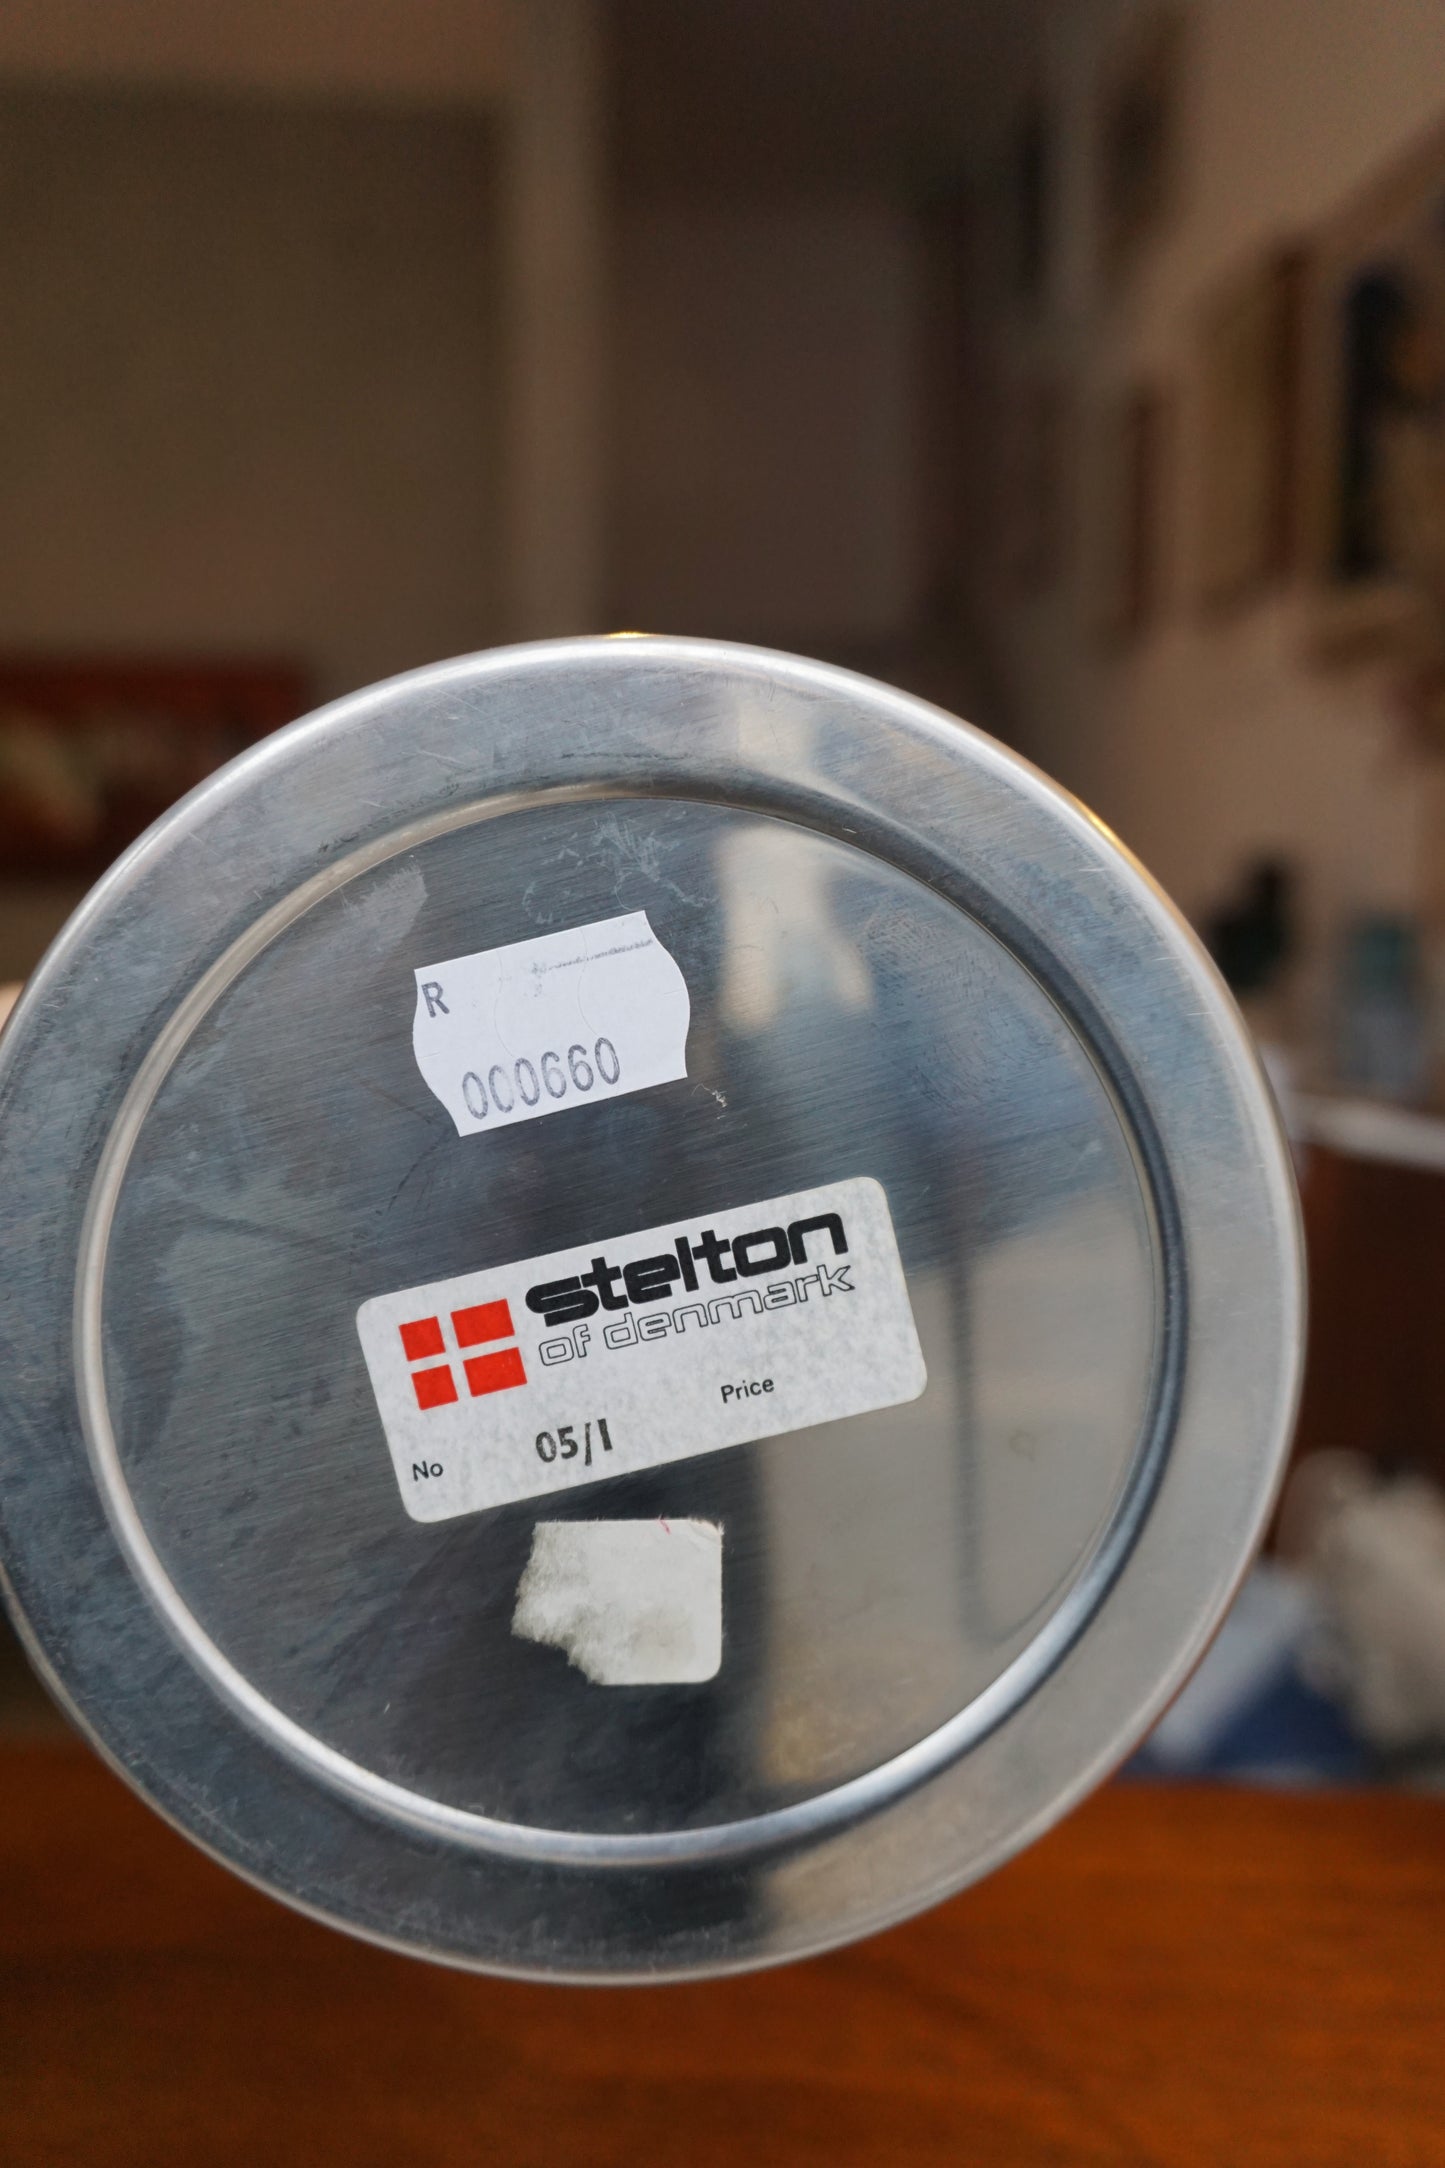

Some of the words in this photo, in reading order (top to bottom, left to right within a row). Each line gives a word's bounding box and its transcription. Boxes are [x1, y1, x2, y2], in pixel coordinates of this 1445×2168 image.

[421, 981, 450, 1018] R
[462, 1037, 620, 1120] 000660
[525, 1212, 849, 1328] stelton
[538, 1323, 591, 1367] of
[603, 1264, 856, 1350] denmark
[720, 1378, 775, 1404] Price
[412, 1460, 444, 1482] No
